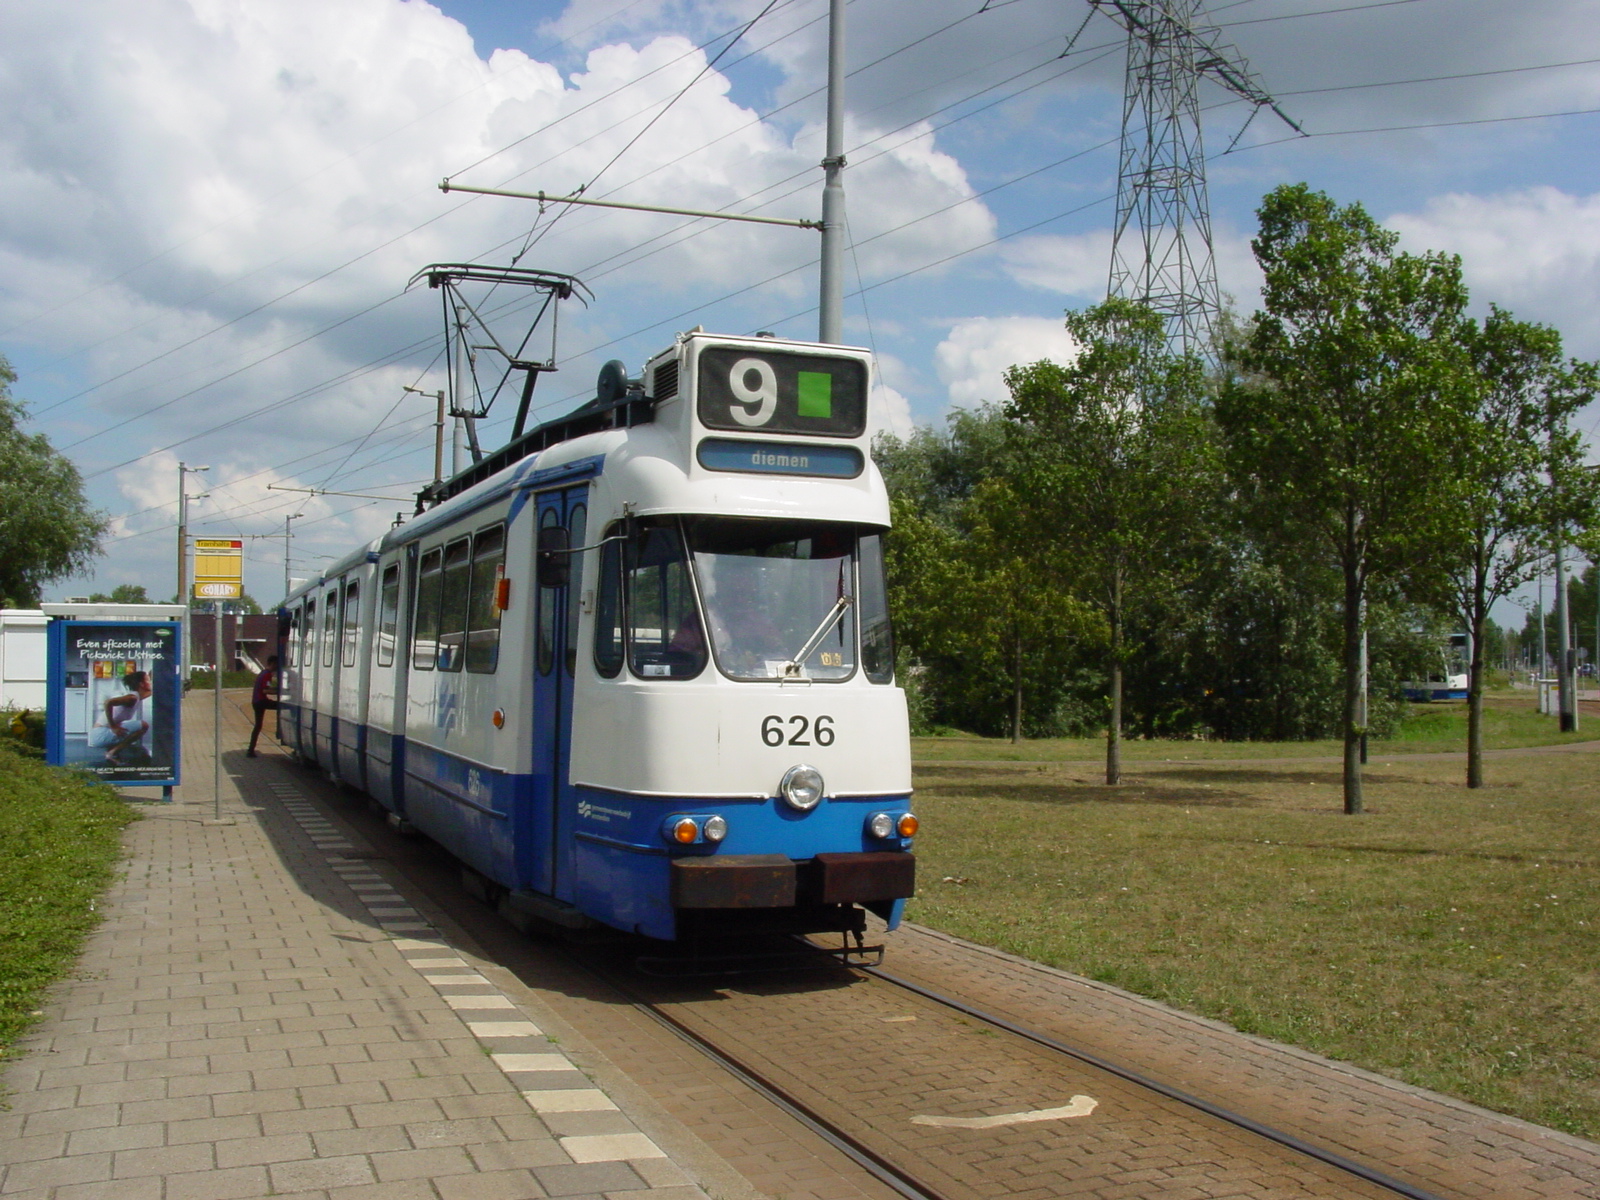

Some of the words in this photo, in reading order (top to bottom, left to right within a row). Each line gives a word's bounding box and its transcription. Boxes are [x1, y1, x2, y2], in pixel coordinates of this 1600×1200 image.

[729, 357, 777, 427] 9
[752, 450, 808, 468] diemen
[76, 638, 100, 649] Even
[102, 638, 141, 651] afkoelen
[145, 639, 164, 649] met
[79, 649, 126, 659] Pickwick
[761, 714, 836, 747] 626
